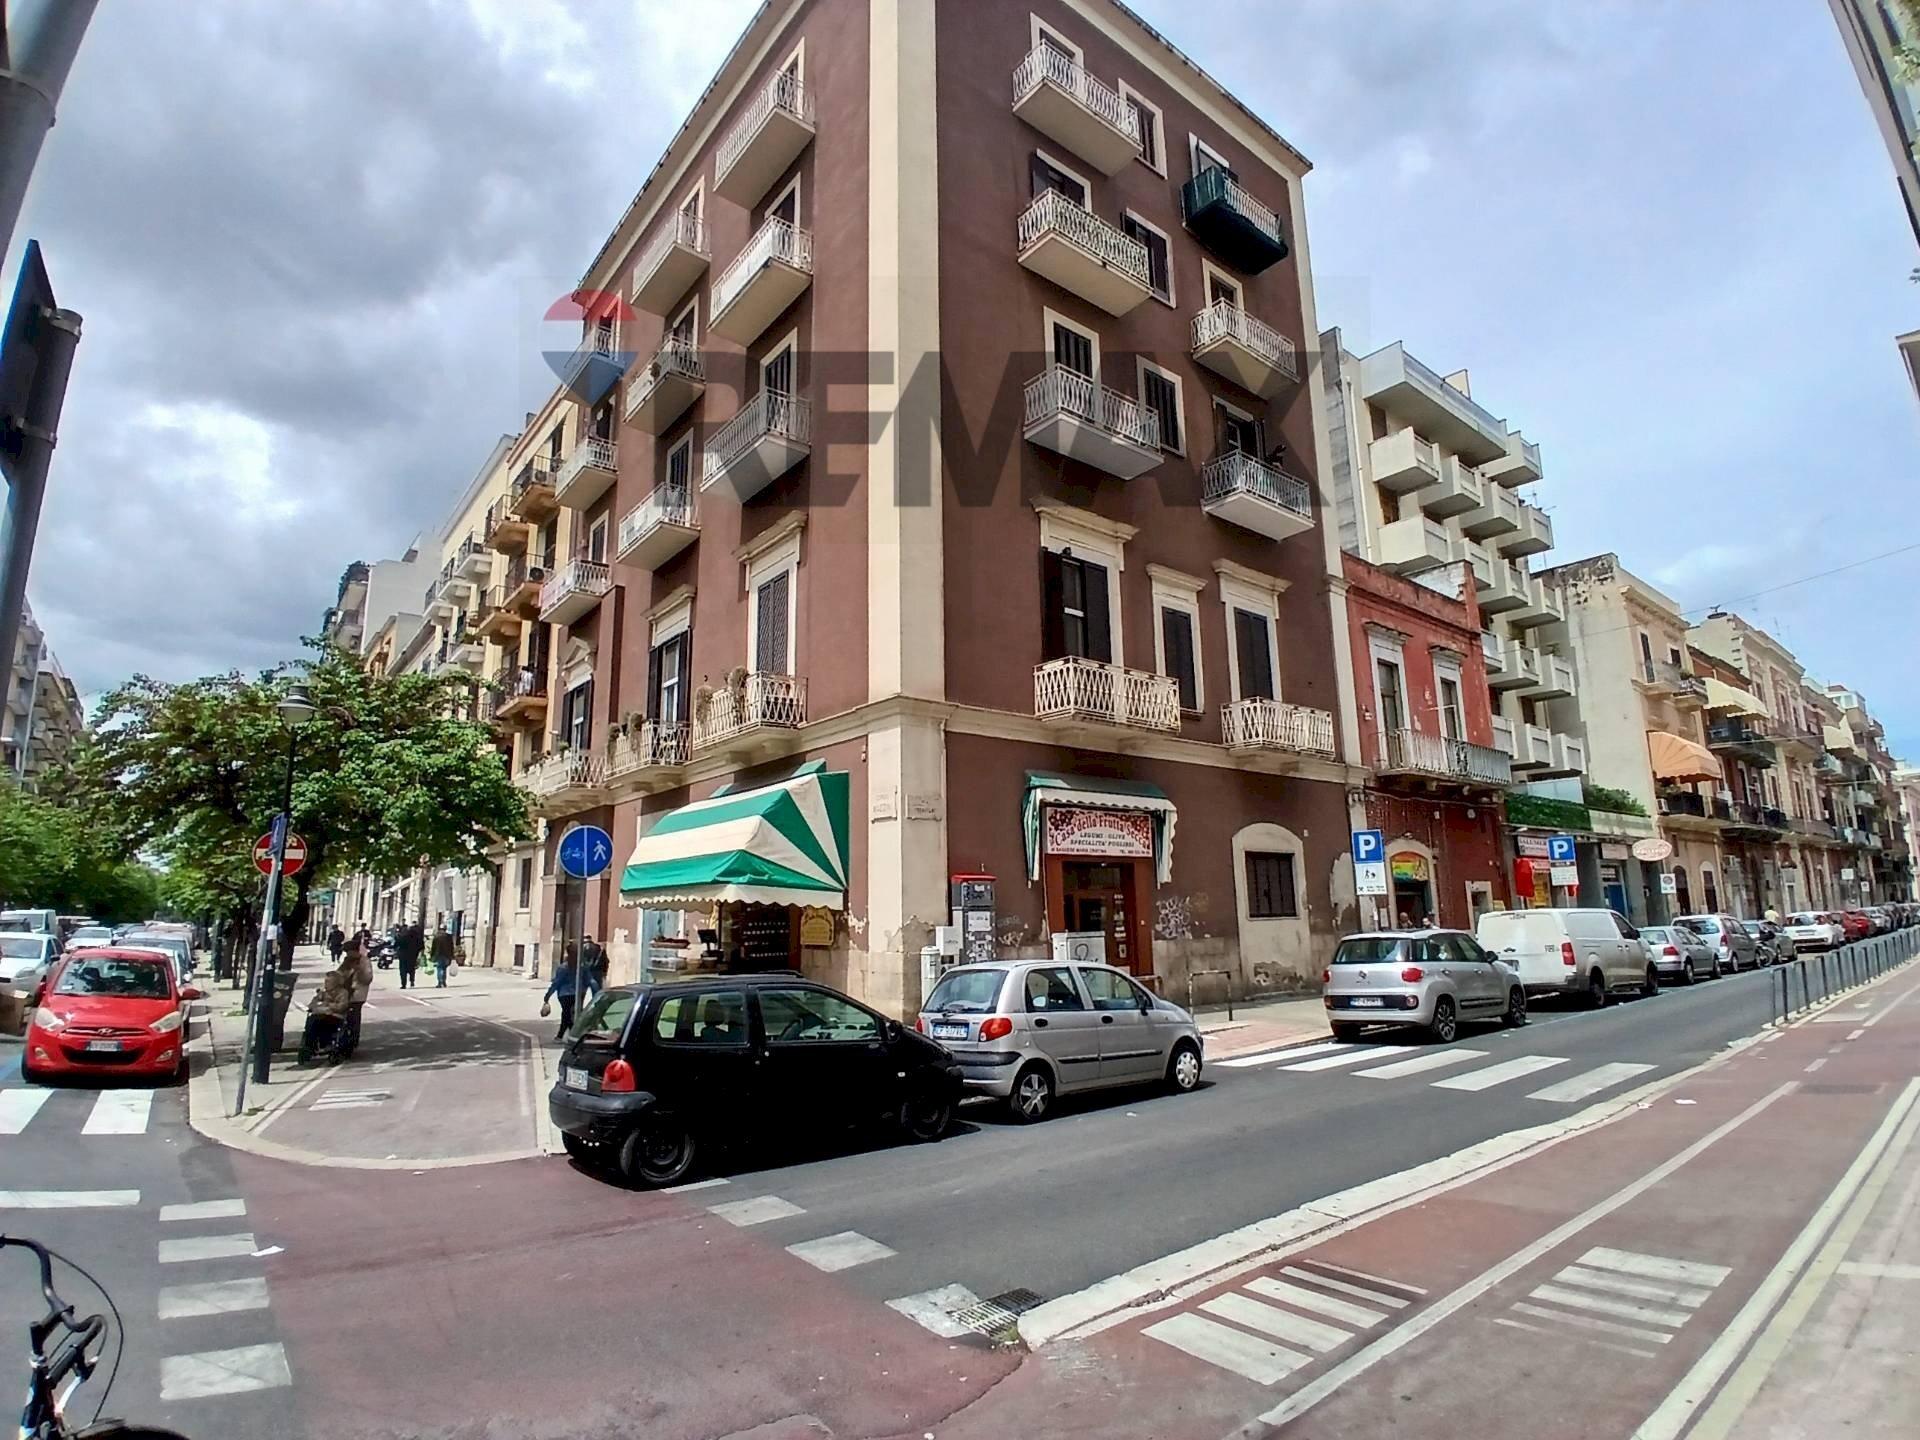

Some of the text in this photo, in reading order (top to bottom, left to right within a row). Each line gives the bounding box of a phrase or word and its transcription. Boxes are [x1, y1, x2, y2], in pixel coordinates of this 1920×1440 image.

[1055, 815, 1150, 850] Casa della Frutta Secca
[1358, 835, 1376, 859] P
[1552, 840, 1569, 859] P
